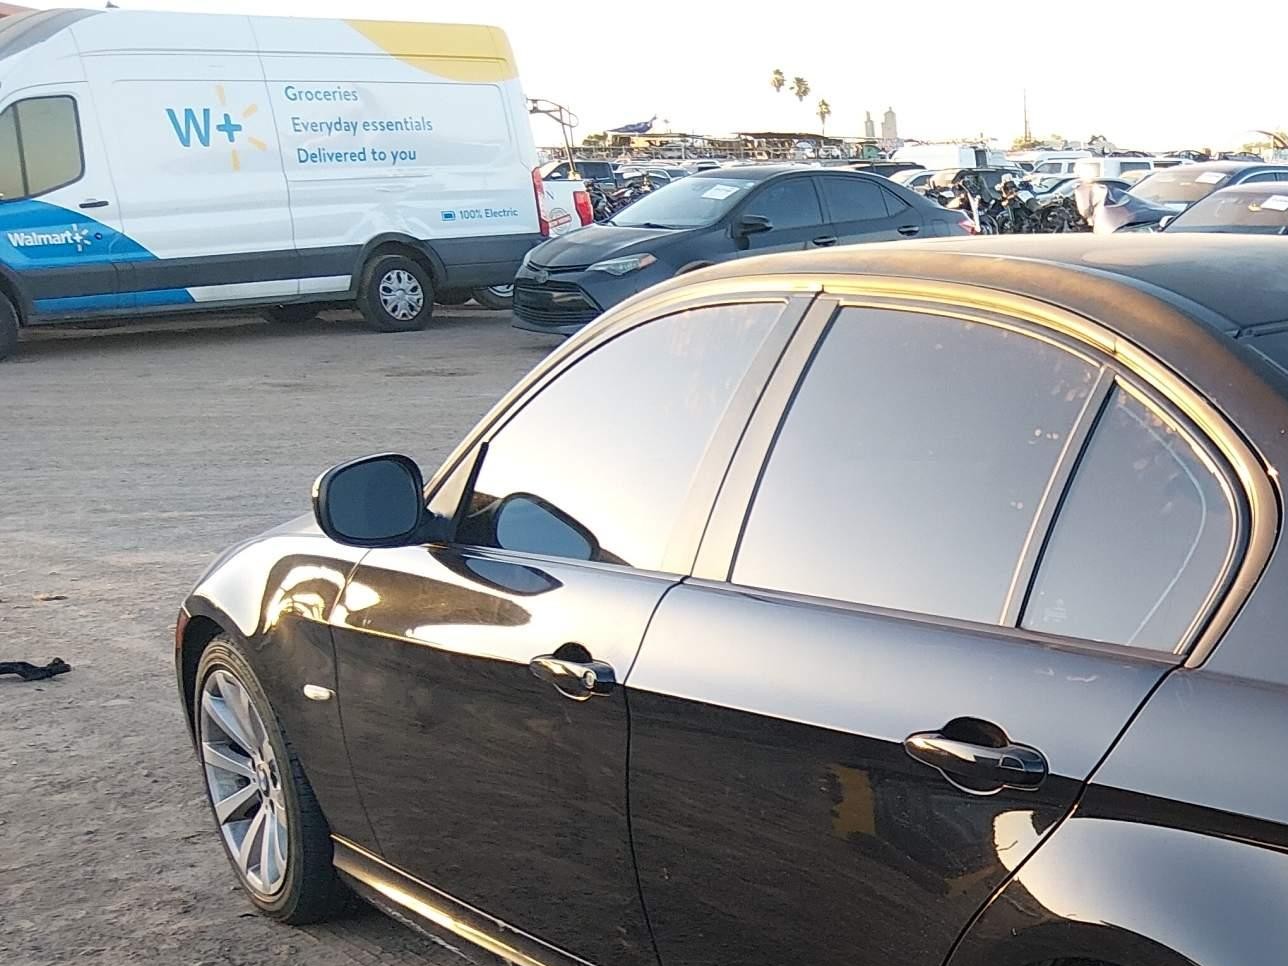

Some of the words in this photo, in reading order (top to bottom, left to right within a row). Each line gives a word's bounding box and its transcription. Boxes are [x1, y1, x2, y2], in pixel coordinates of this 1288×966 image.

[284, 86, 359, 102] Groceries
[291, 117, 358, 136] Everyday
[361, 116, 433, 132] essentials
[297, 147, 366, 164] Delivered
[371, 148, 387, 162] to
[391, 150, 417, 165] you
[459, 209, 483, 220] 100%
[484, 207, 519, 218] Electric
